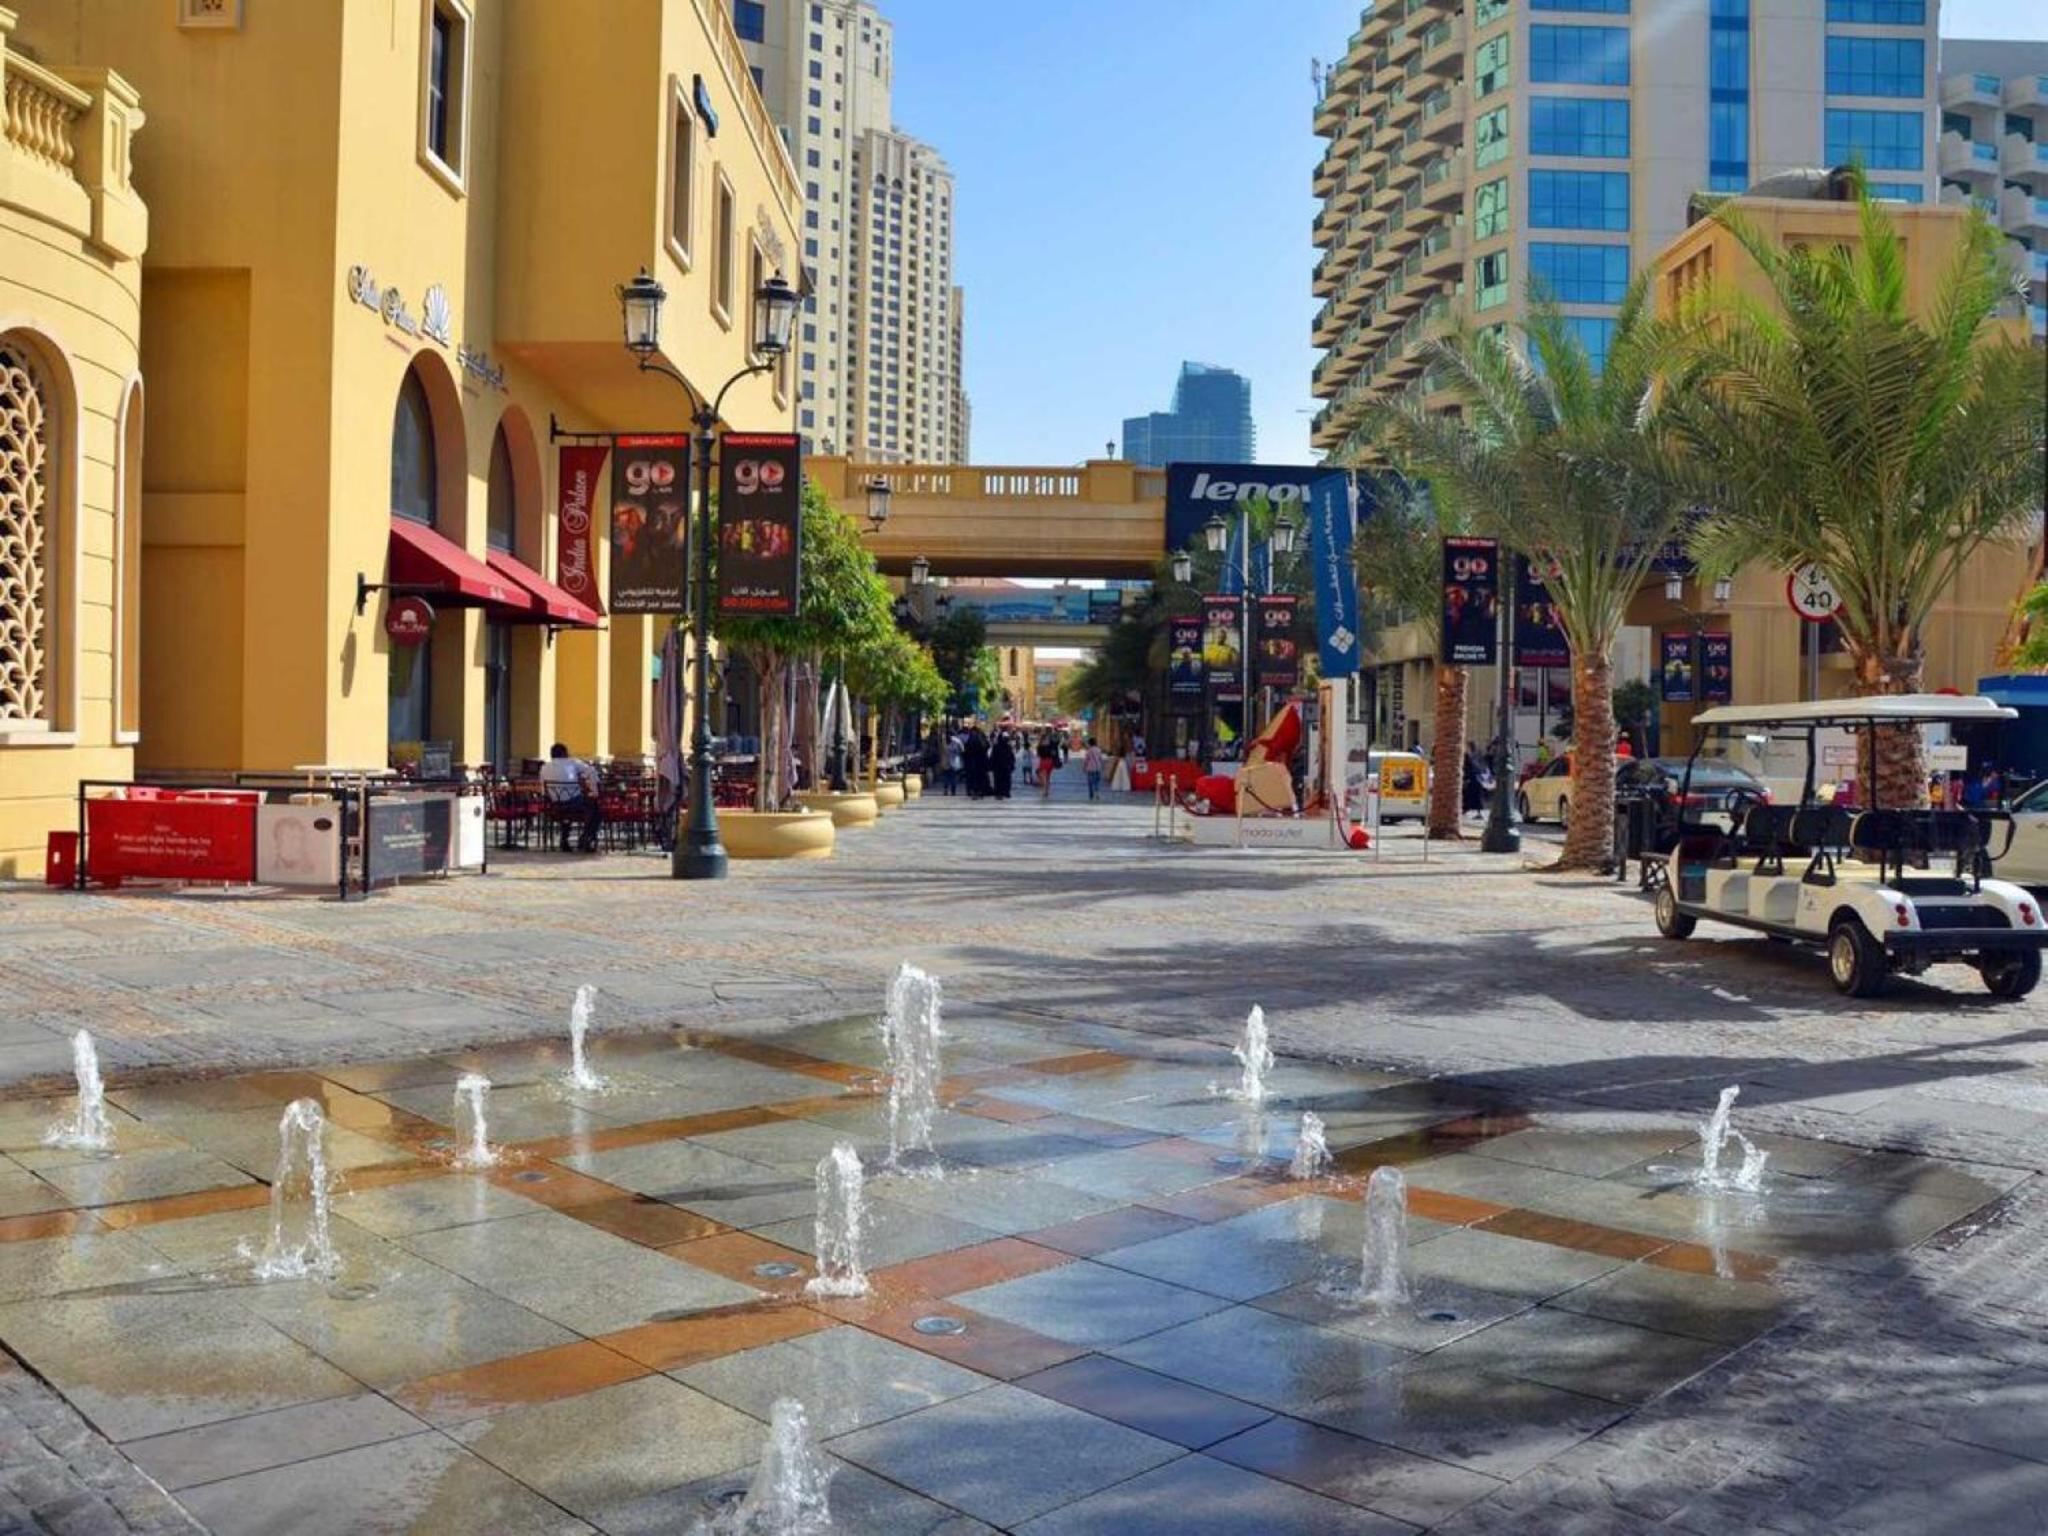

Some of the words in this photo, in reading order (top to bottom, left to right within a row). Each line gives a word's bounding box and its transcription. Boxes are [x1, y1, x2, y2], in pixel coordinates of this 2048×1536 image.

[626, 461, 675, 496] go
[736, 460, 784, 496] go
[1454, 558, 1488, 581] go
[1804, 591, 1832, 608] 40
